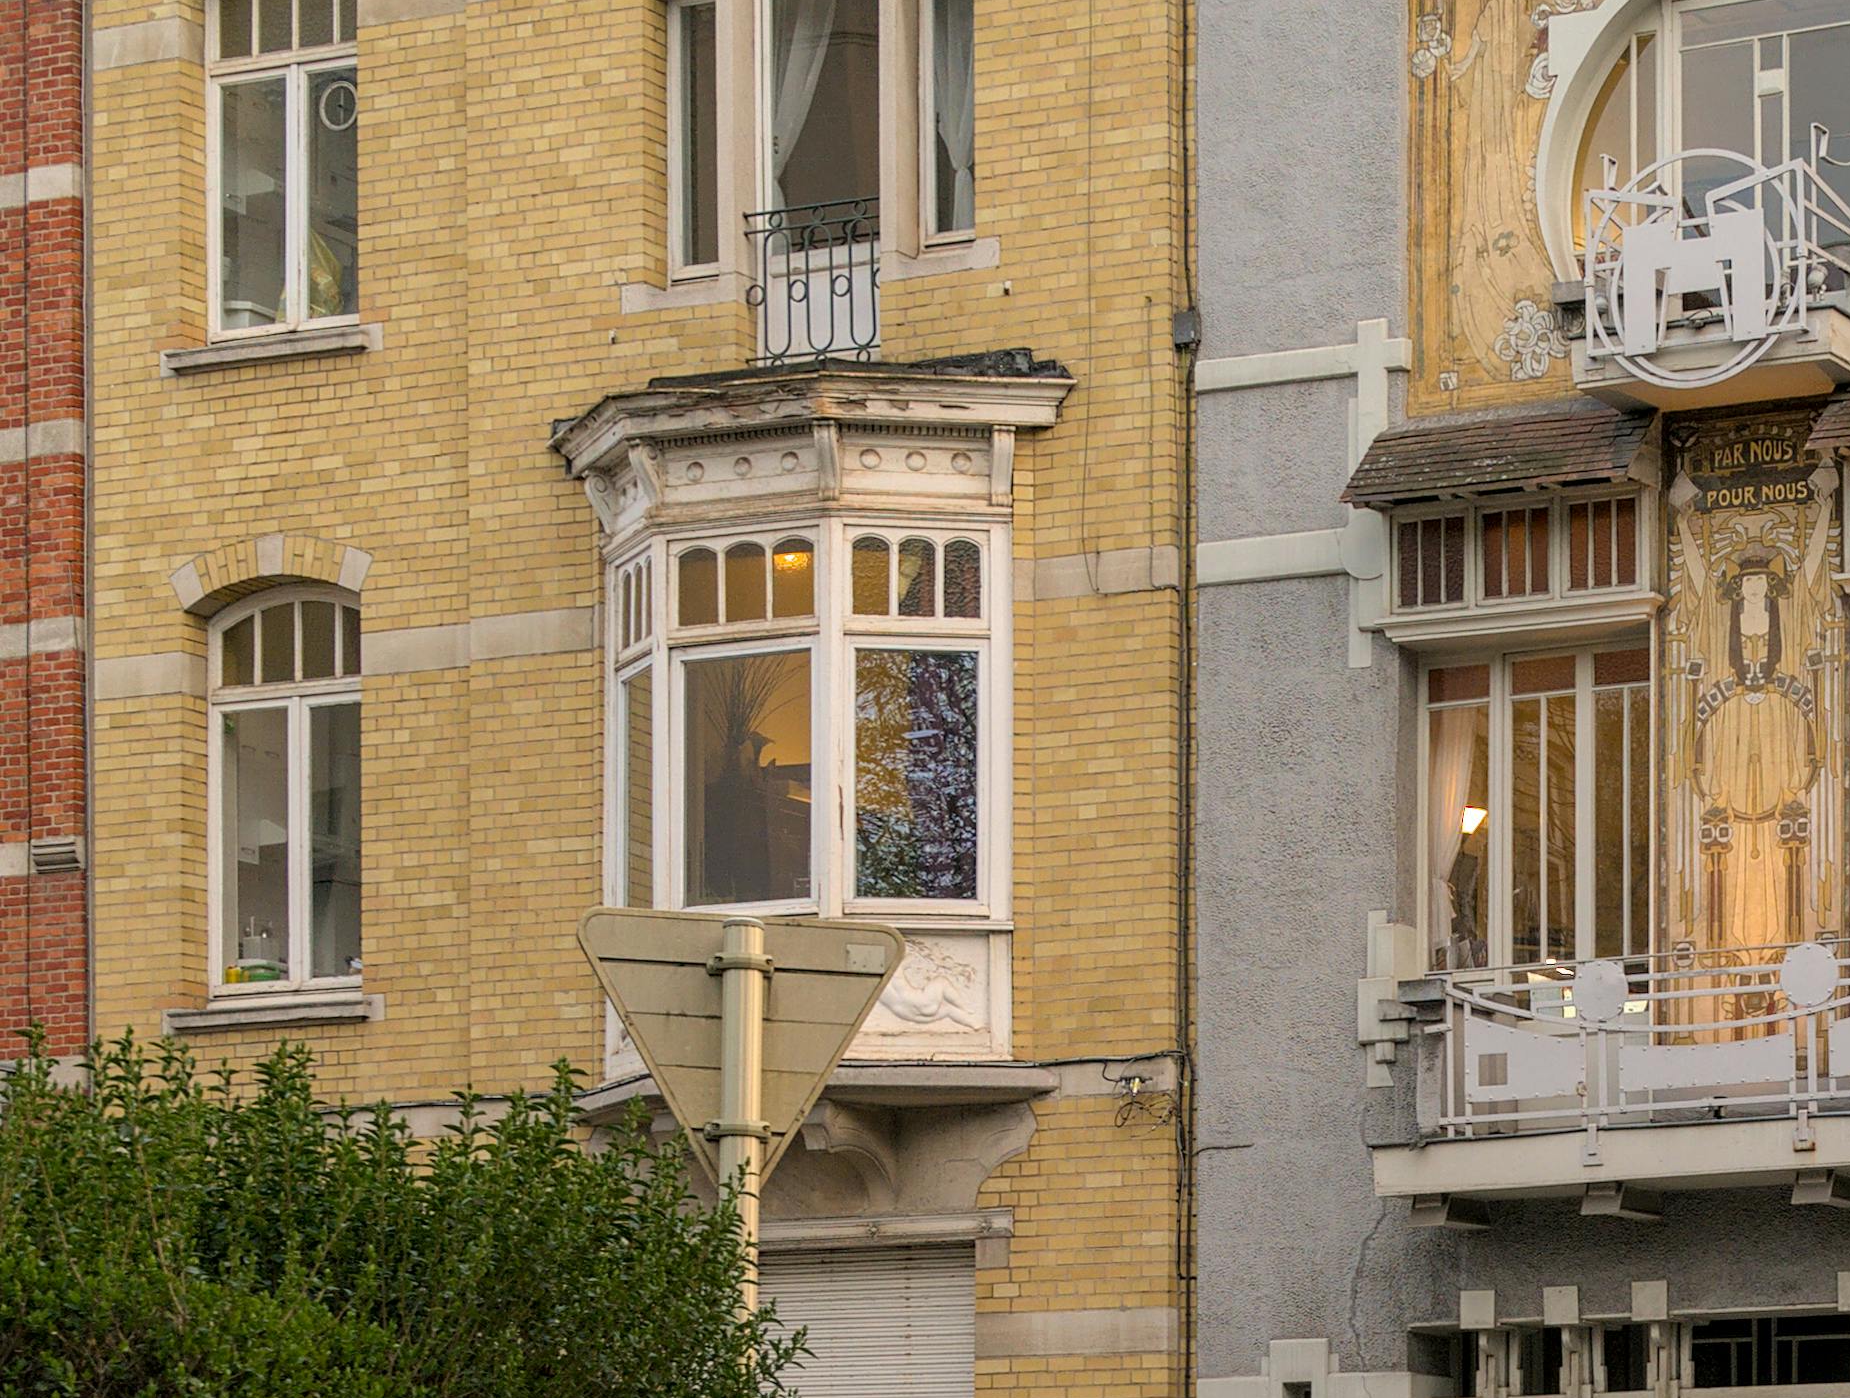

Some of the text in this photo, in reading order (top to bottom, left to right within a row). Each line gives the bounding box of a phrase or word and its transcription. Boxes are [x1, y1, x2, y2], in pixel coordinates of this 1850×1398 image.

[1714, 440, 1794, 467] PAR NOUS
[1706, 480, 1808, 508] POUR NOUS
